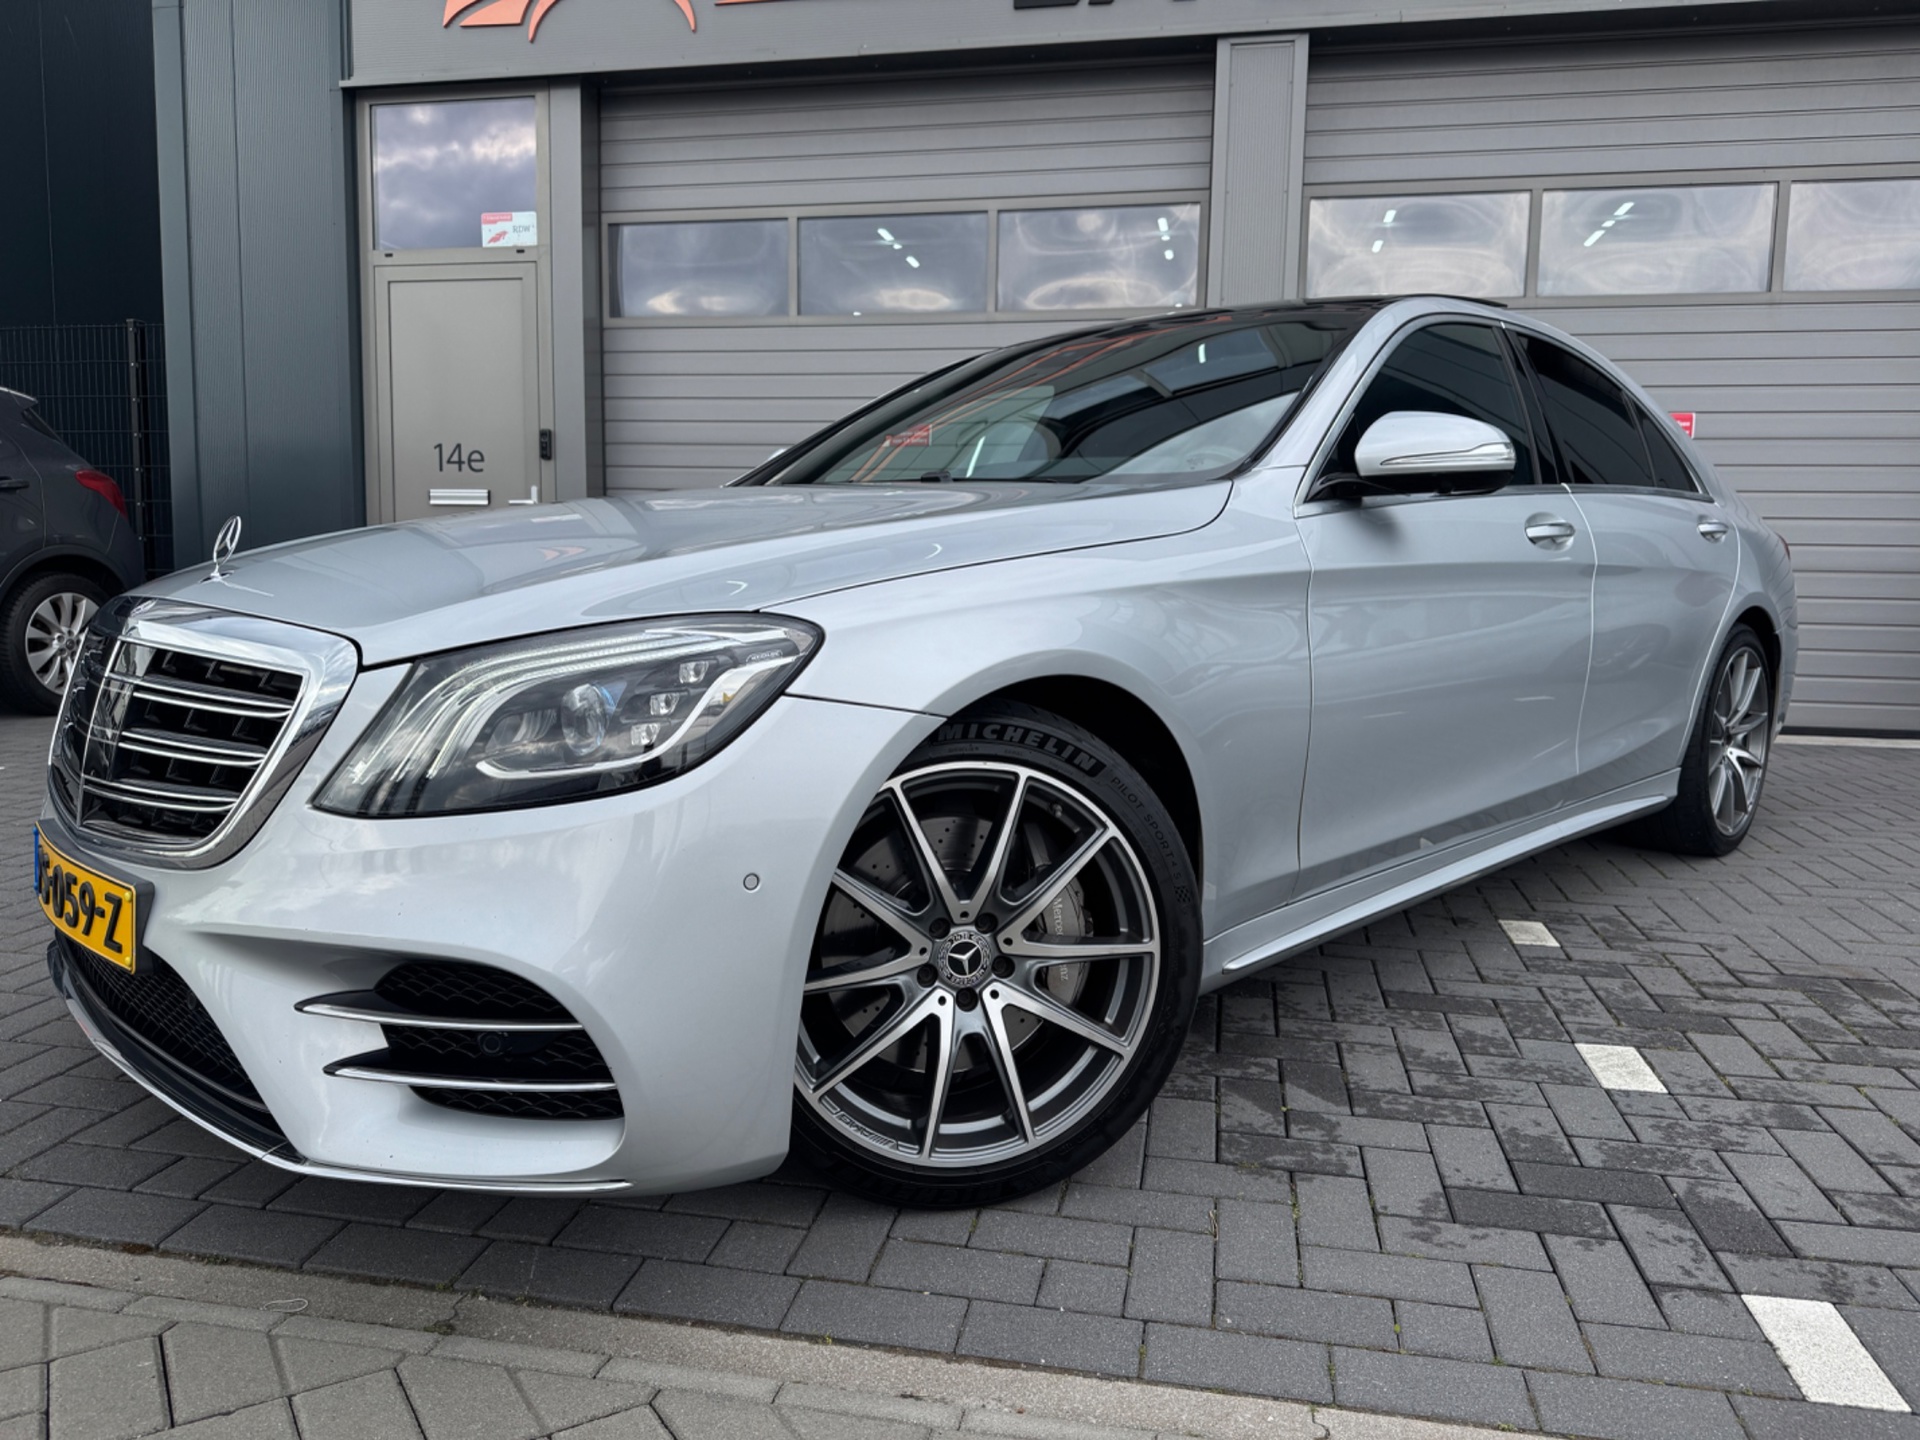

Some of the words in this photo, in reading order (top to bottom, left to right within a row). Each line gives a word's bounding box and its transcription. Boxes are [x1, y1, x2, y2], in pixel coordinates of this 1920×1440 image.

[433, 443, 485, 473] 14e
[938, 722, 1098, 773] MICHELIN
[1110, 777, 1145, 810] PILOT
[1144, 814, 1175, 859] SPORT
